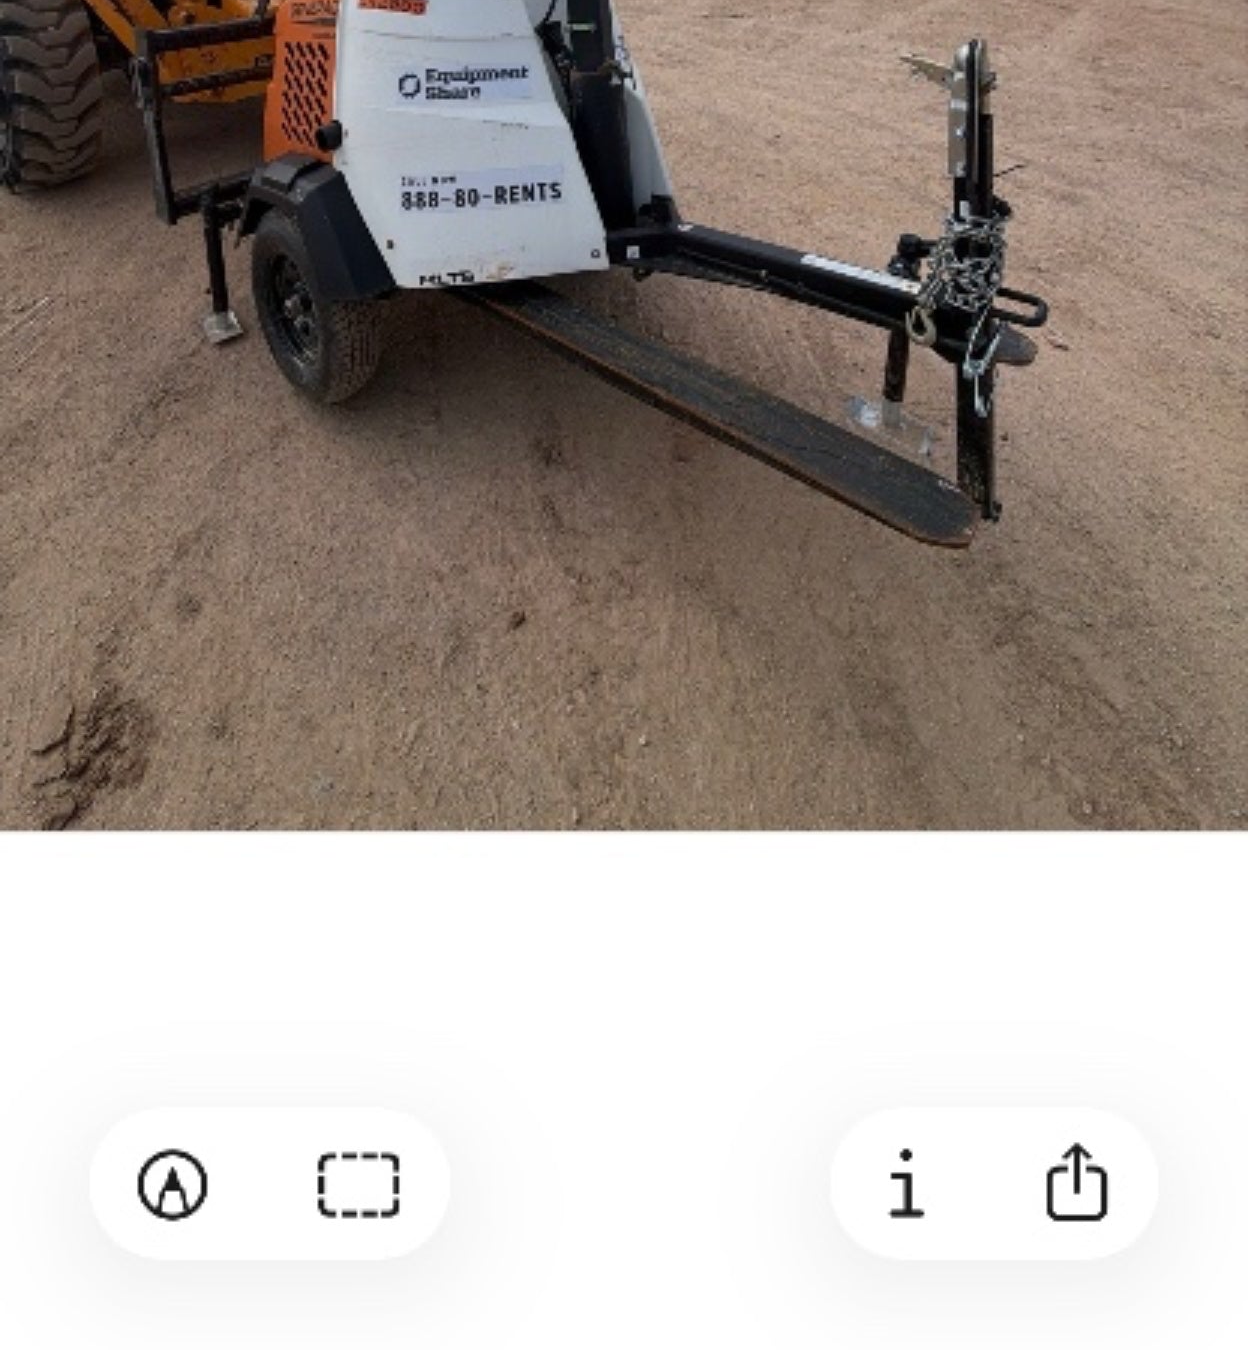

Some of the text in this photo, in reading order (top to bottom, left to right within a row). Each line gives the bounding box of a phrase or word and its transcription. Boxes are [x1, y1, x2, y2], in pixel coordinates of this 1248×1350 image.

[425, 65, 529, 84] Equipment
[425, 86, 481, 100] Share
[401, 182, 562, 211] 888-80-RENTS
